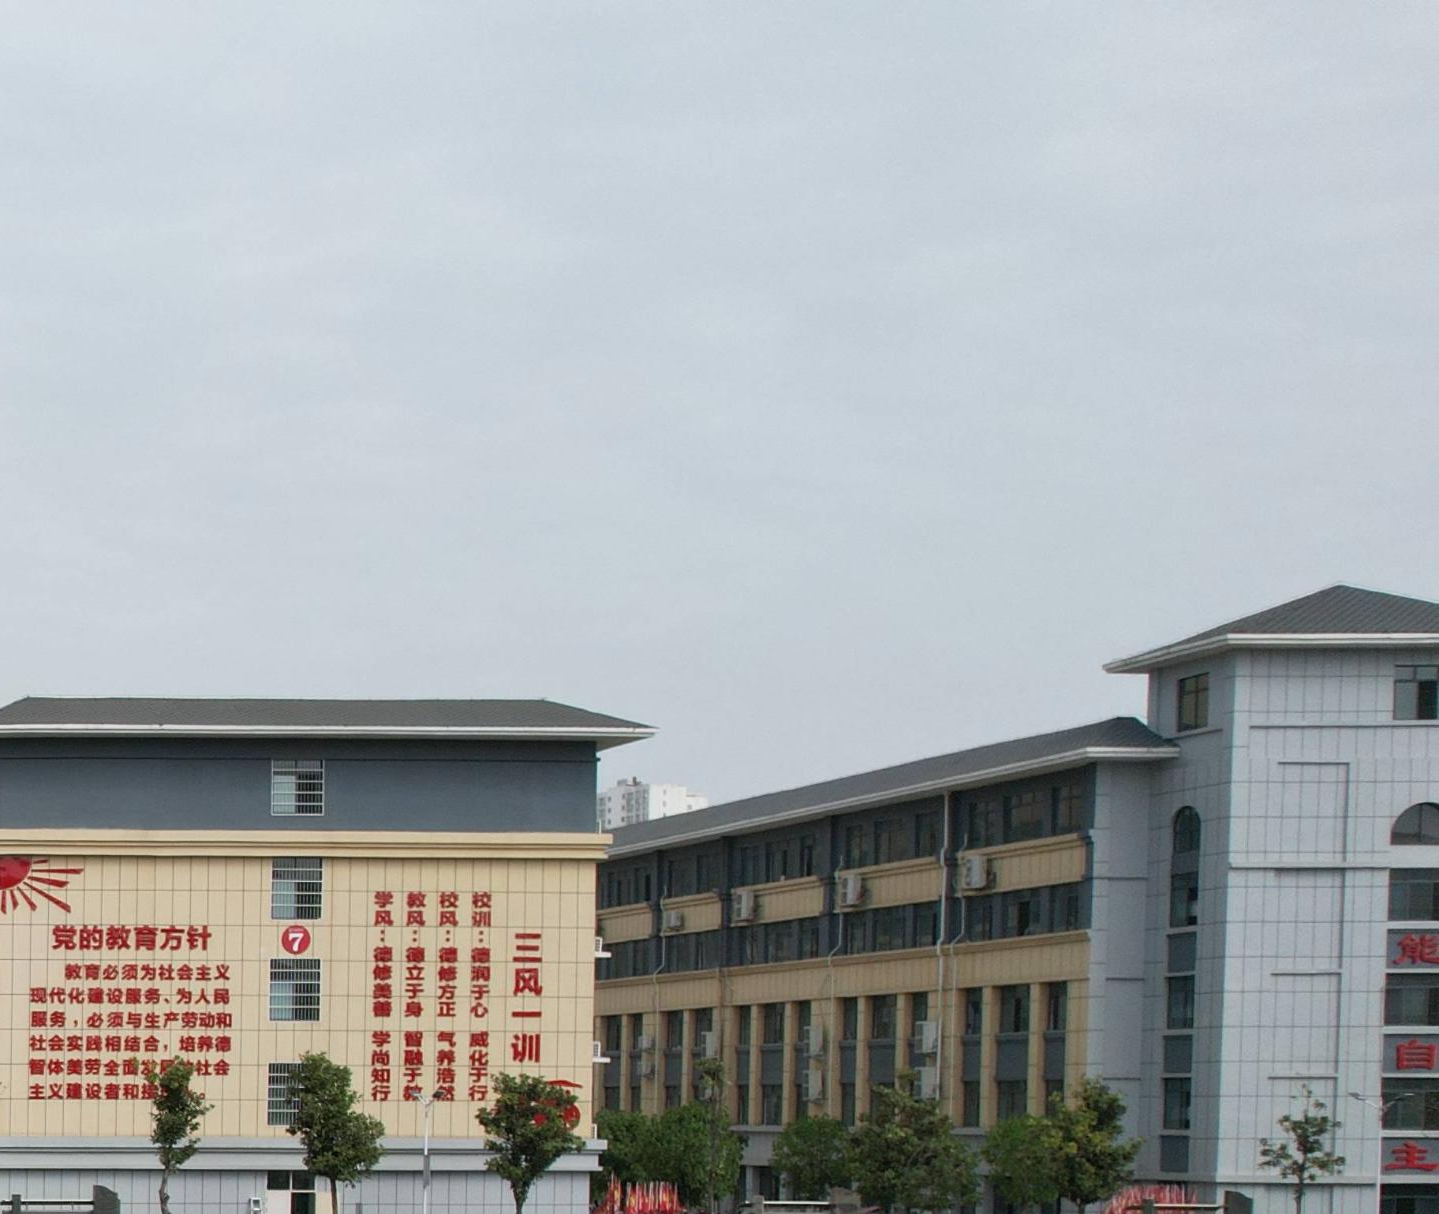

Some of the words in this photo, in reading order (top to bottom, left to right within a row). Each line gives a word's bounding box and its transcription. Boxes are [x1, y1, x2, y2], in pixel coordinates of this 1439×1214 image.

[52, 925, 212, 951] 党的教育方针
[288, 932, 304, 952] 7
[65, 963, 230, 981] 教育必须为社会主义
[30, 986, 230, 1005] 现代化建设服务、为人民
[512, 932, 543, 1063] 三风一训
[31, 1011, 233, 1029] 服务，必须与生产劳动和
[29, 1035, 232, 1053] 社会实践相结合，培养德
[1396, 1037, 1437, 1070] 自
[28, 1058, 230, 1077] 智体美劳全面发展社会
[371, 1030, 391, 1101] 学尚知行
[436, 1030, 456, 1101] 气养浩然
[468, 1030, 489, 1101] 威化于行
[29, 1082, 205, 1101] 主义建设者和接。
[1384, 1140, 1439, 1172] 主
